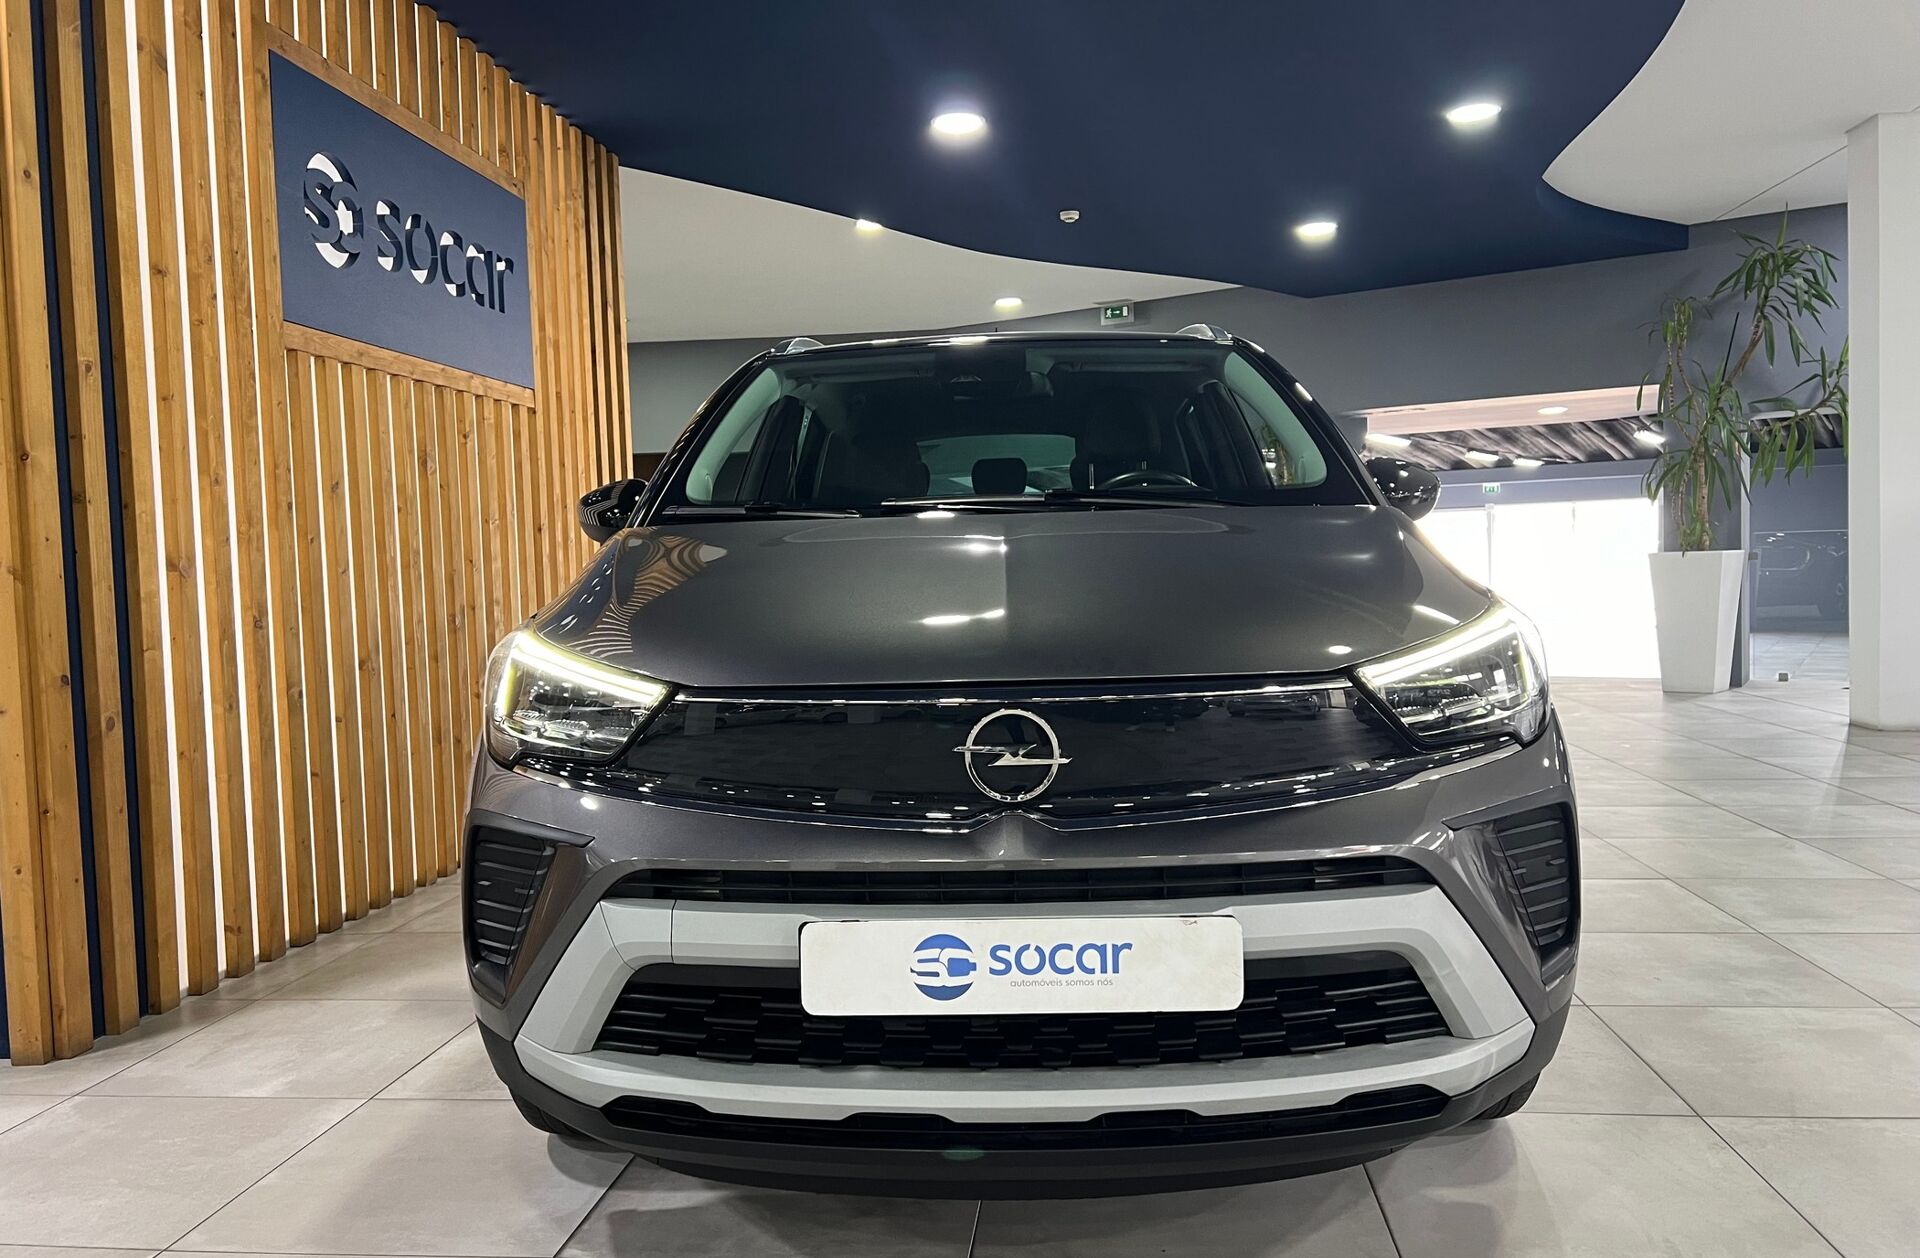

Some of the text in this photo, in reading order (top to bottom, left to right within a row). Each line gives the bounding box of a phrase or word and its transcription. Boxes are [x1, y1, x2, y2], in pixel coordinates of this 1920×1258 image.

[376, 199, 514, 314] socar
[989, 942, 1133, 976] socar
[1010, 977, 1114, 987] automóveis somos nós
